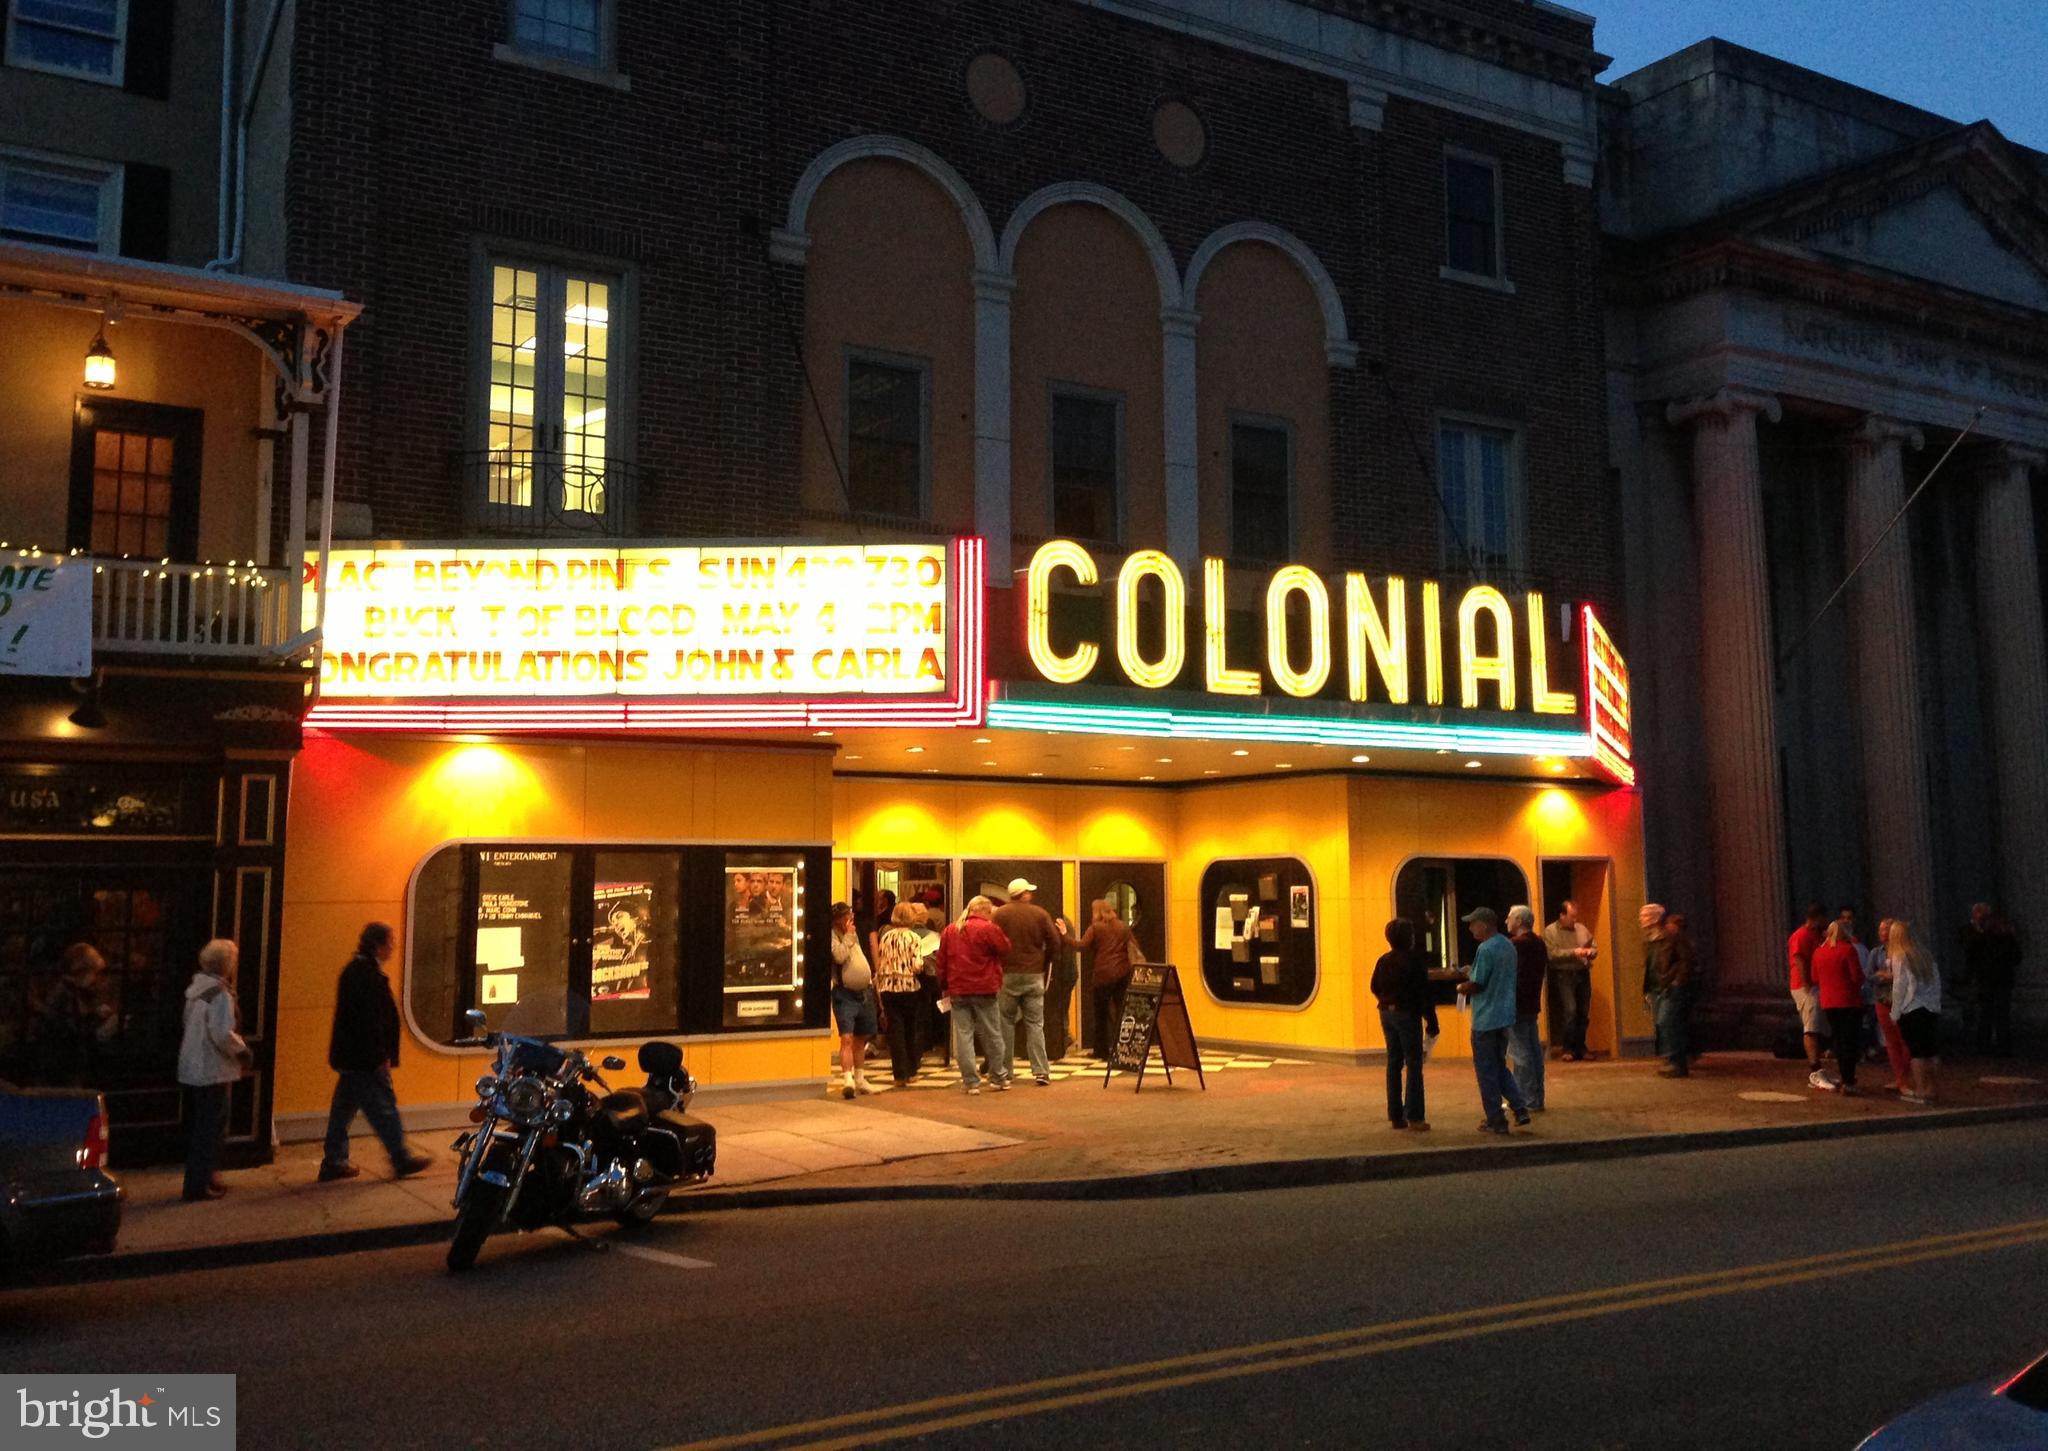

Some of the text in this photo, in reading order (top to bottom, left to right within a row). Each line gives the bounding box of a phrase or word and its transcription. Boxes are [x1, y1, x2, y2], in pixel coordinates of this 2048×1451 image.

[303, 560, 408, 592] PLAC
[700, 556, 776, 591] SUN
[364, 605, 505, 638] BUCKT
[518, 605, 564, 637] OF
[722, 602, 799, 635] MAY
[817, 603, 835, 634] 4
[1027, 540, 1576, 714] COLONIAL
[306, 649, 648, 683] ONGRATULATIONS
[812, 647, 944, 681] CARLA
[493, 851, 557, 861] ENTERTAINMENT
